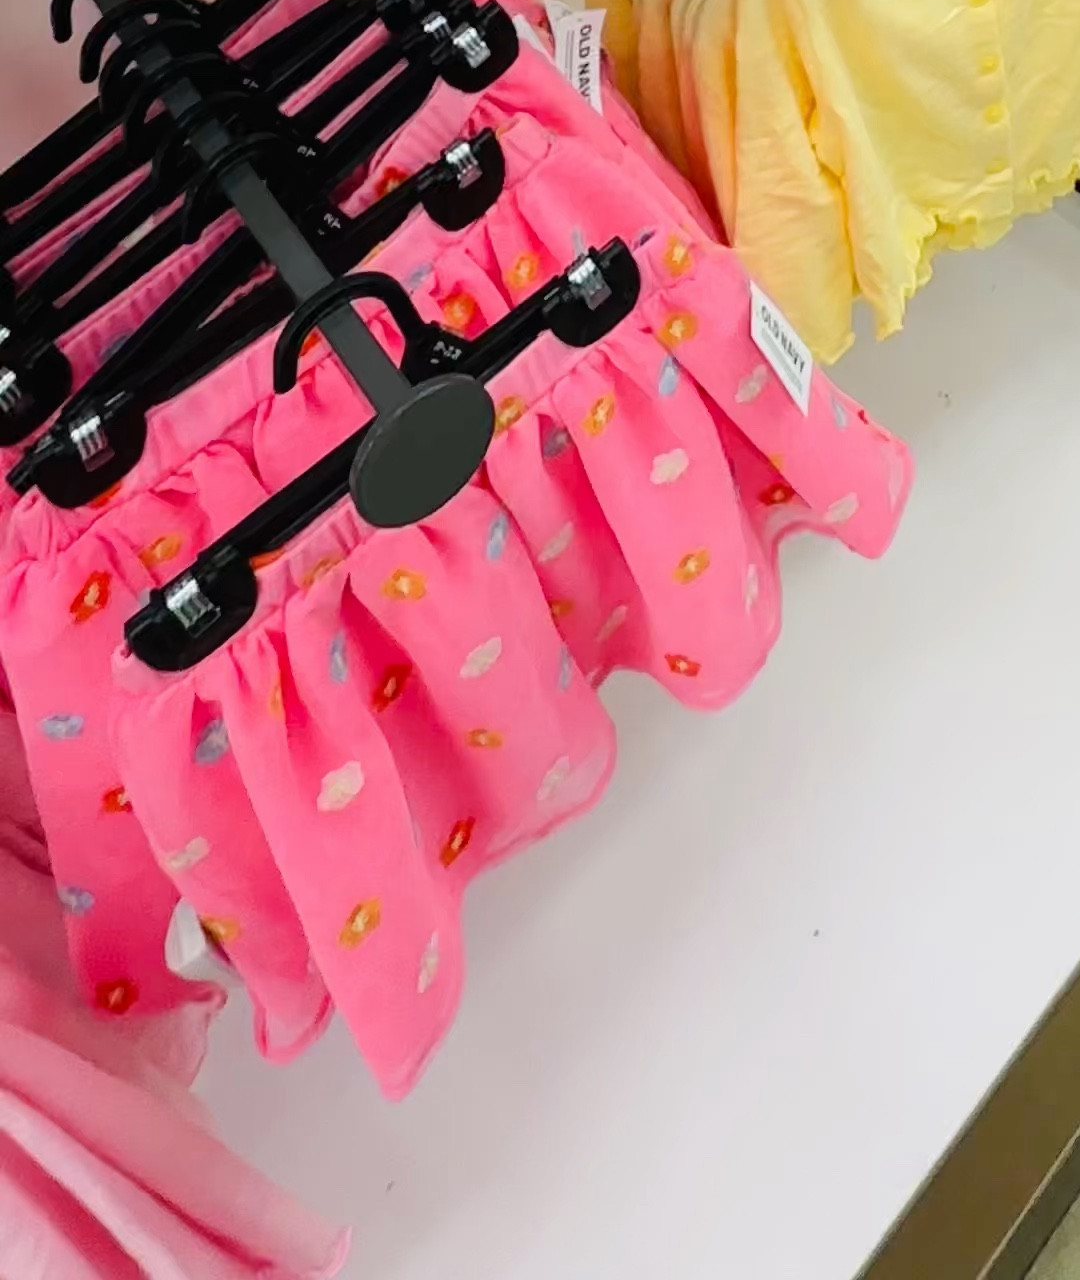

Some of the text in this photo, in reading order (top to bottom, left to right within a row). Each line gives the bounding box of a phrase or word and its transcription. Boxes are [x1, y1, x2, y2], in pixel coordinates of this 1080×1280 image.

[577, 24, 592, 104] OLD NAV
[760, 305, 779, 339] OLD
[781, 332, 805, 373] NAVY
